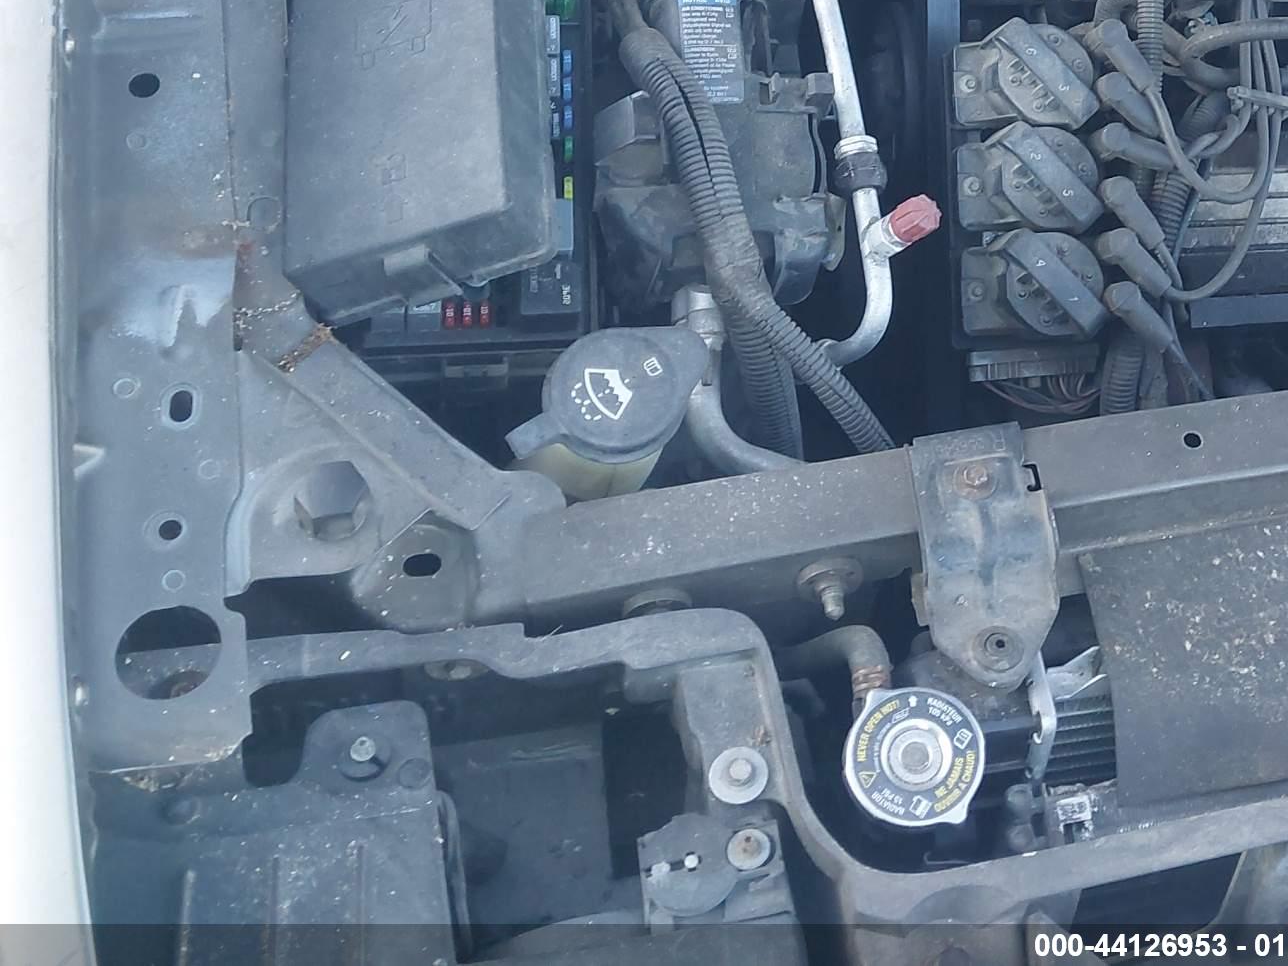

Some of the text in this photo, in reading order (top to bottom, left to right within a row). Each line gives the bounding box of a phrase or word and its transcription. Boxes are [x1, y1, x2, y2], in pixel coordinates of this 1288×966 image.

[1030, 153, 1075, 197] 2 5
[927, 697, 964, 724] RADIATEUR
[857, 733, 870, 762] NEVER
[864, 711, 884, 734] OPEN
[946, 757, 964, 790] JAMAIS
[871, 791, 905, 816] RADIATOR
